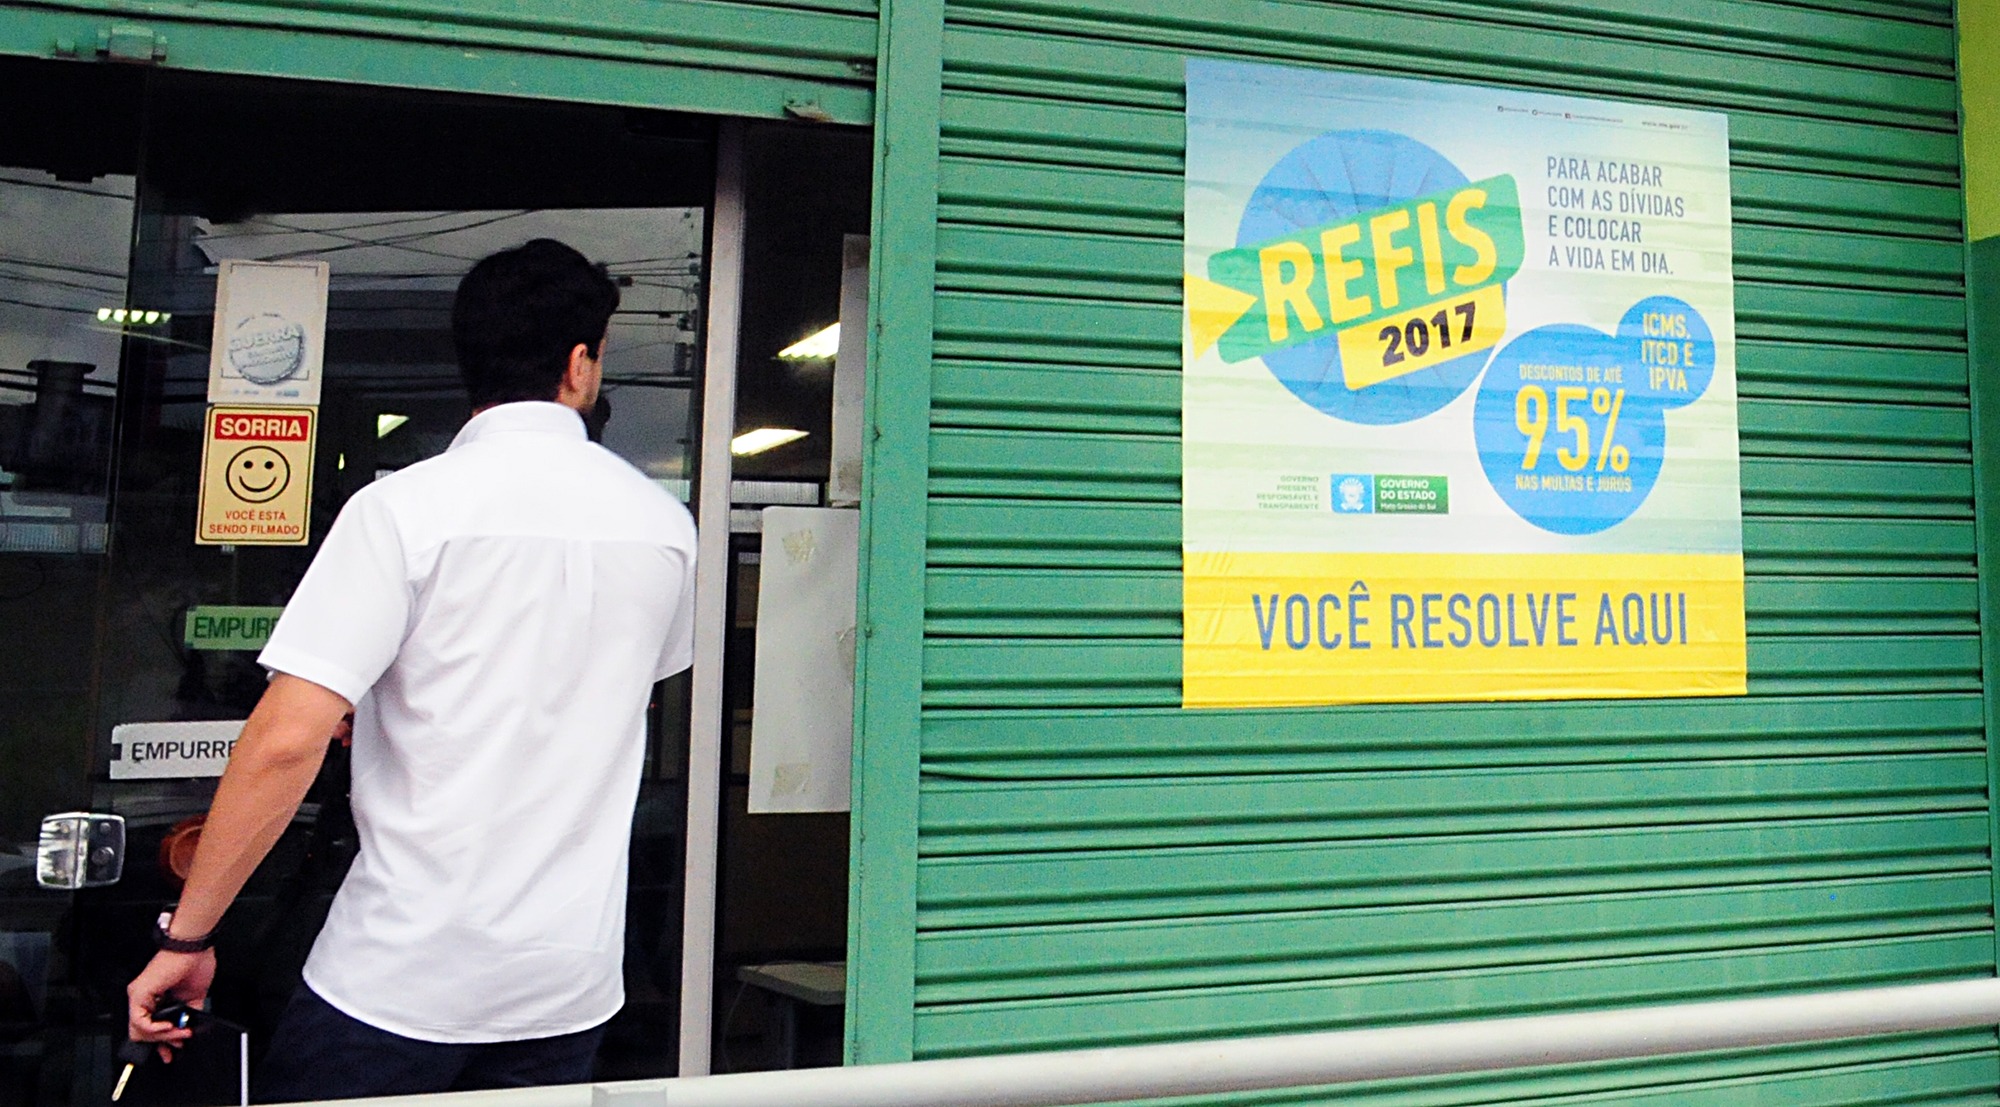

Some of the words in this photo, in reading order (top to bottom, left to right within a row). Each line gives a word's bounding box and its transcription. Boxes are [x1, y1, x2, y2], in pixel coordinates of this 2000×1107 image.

[1547, 156, 1591, 180] PARA
[1597, 160, 1662, 187] ACABAR
[1548, 185, 1584, 209] COM
[1592, 190, 1612, 211] AS
[1619, 188, 1684, 217] DÍVIDAS
[1549, 215, 1557, 237] E
[1564, 216, 1641, 243] COLOCAR
[1259, 188, 1498, 343] REFIS
[1549, 245, 1559, 266] A
[1566, 246, 1605, 270] VIDA
[1611, 250, 1635, 272] EM
[1641, 251, 1674, 275] DIA.
[1378, 301, 1476, 367] 2017
[1641, 340, 1678, 366] ITCD
[1684, 342, 1695, 367] E
[1519, 364, 1583, 382] DESCONTOS
[1587, 366, 1600, 383] DE
[1604, 365, 1623, 383] ATÉ
[1649, 367, 1688, 392] IPVA
[220, 418, 302, 437] SORRIA
[1515, 384, 1630, 472] 95%
[1380, 479, 1429, 489] GOVERNO
[1380, 490, 1396, 500] DO
[1397, 490, 1437, 500] ESTADO
[1515, 474, 1538, 490] NAS
[1542, 475, 1583, 491] MULTAS
[1587, 476, 1594, 491] E
[1597, 476, 1632, 492] JUROS
[209, 525, 247, 534] SENDO
[251, 525, 300, 535] FILMADO
[1251, 581, 1371, 650] VOCÊ
[1390, 593, 1577, 648] RESOLVE
[1594, 593, 1687, 645] AQUI
